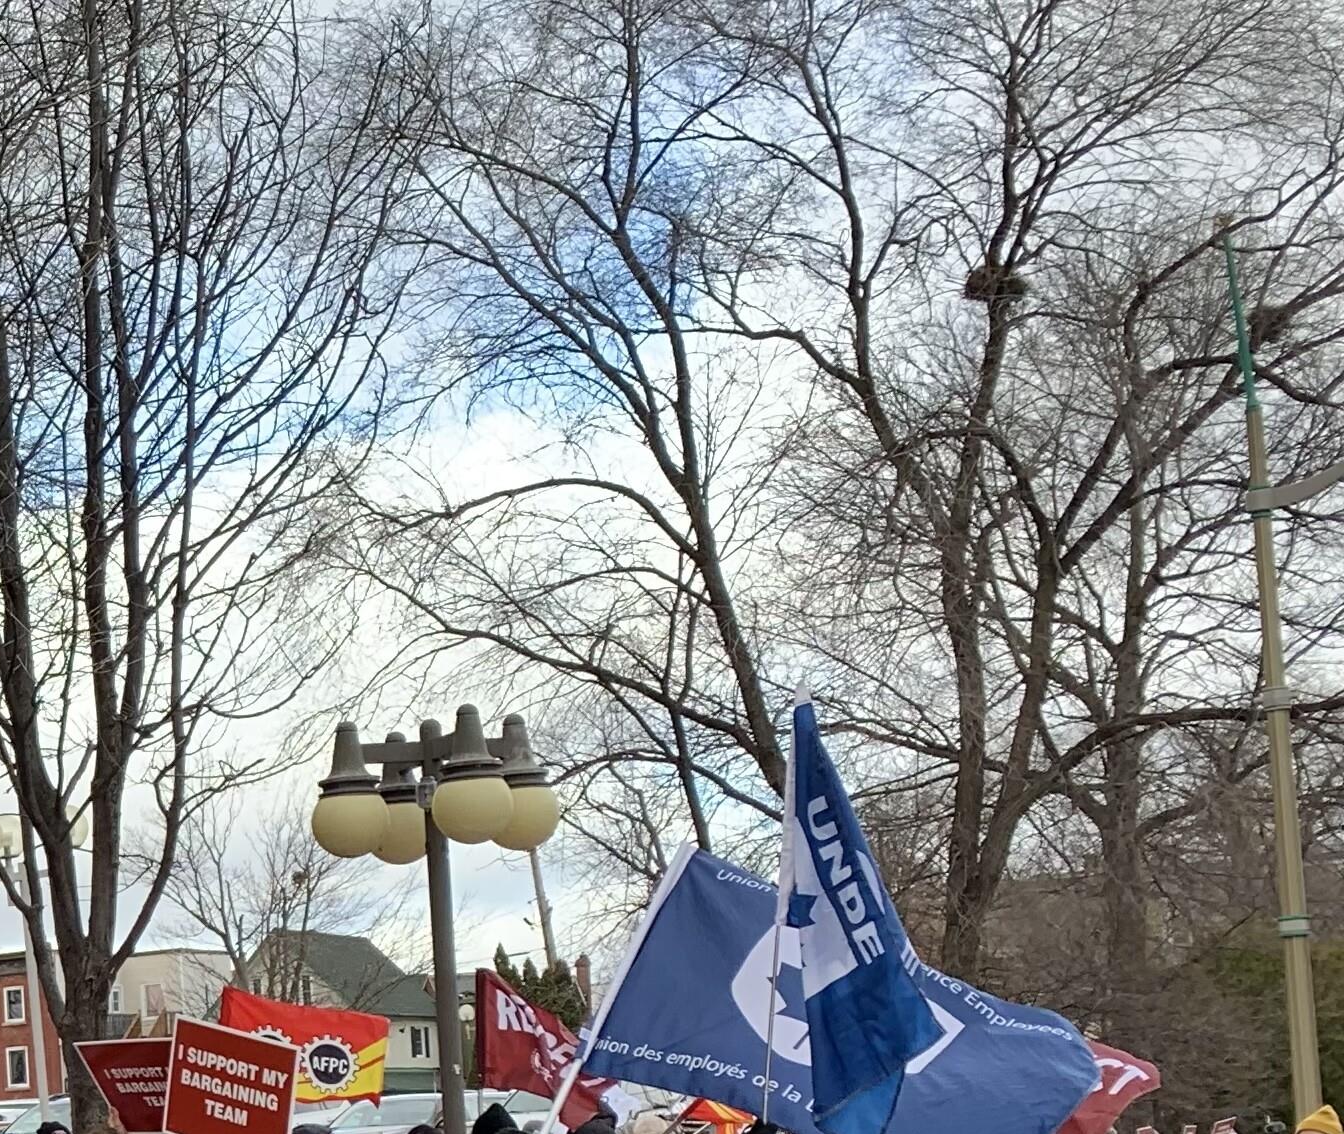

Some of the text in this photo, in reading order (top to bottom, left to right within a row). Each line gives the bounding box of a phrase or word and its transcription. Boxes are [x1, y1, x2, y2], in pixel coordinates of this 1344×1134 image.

[715, 868, 772, 893] Union
[806, 795, 886, 966] UNDE
[963, 989, 1074, 1041] Employees
[111, 1066, 164, 1080] SUPPORT
[177, 1043, 289, 1090] I SUPPORT MY
[311, 1055, 350, 1076] AFPC
[594, 1036, 630, 1055] nion
[632, 1043, 665, 1062] des
[665, 1053, 749, 1080] employés
[781, 1082, 803, 1104] la
[180, 1069, 279, 1113] BARGAINING
[204, 1098, 249, 1127] TEAM
